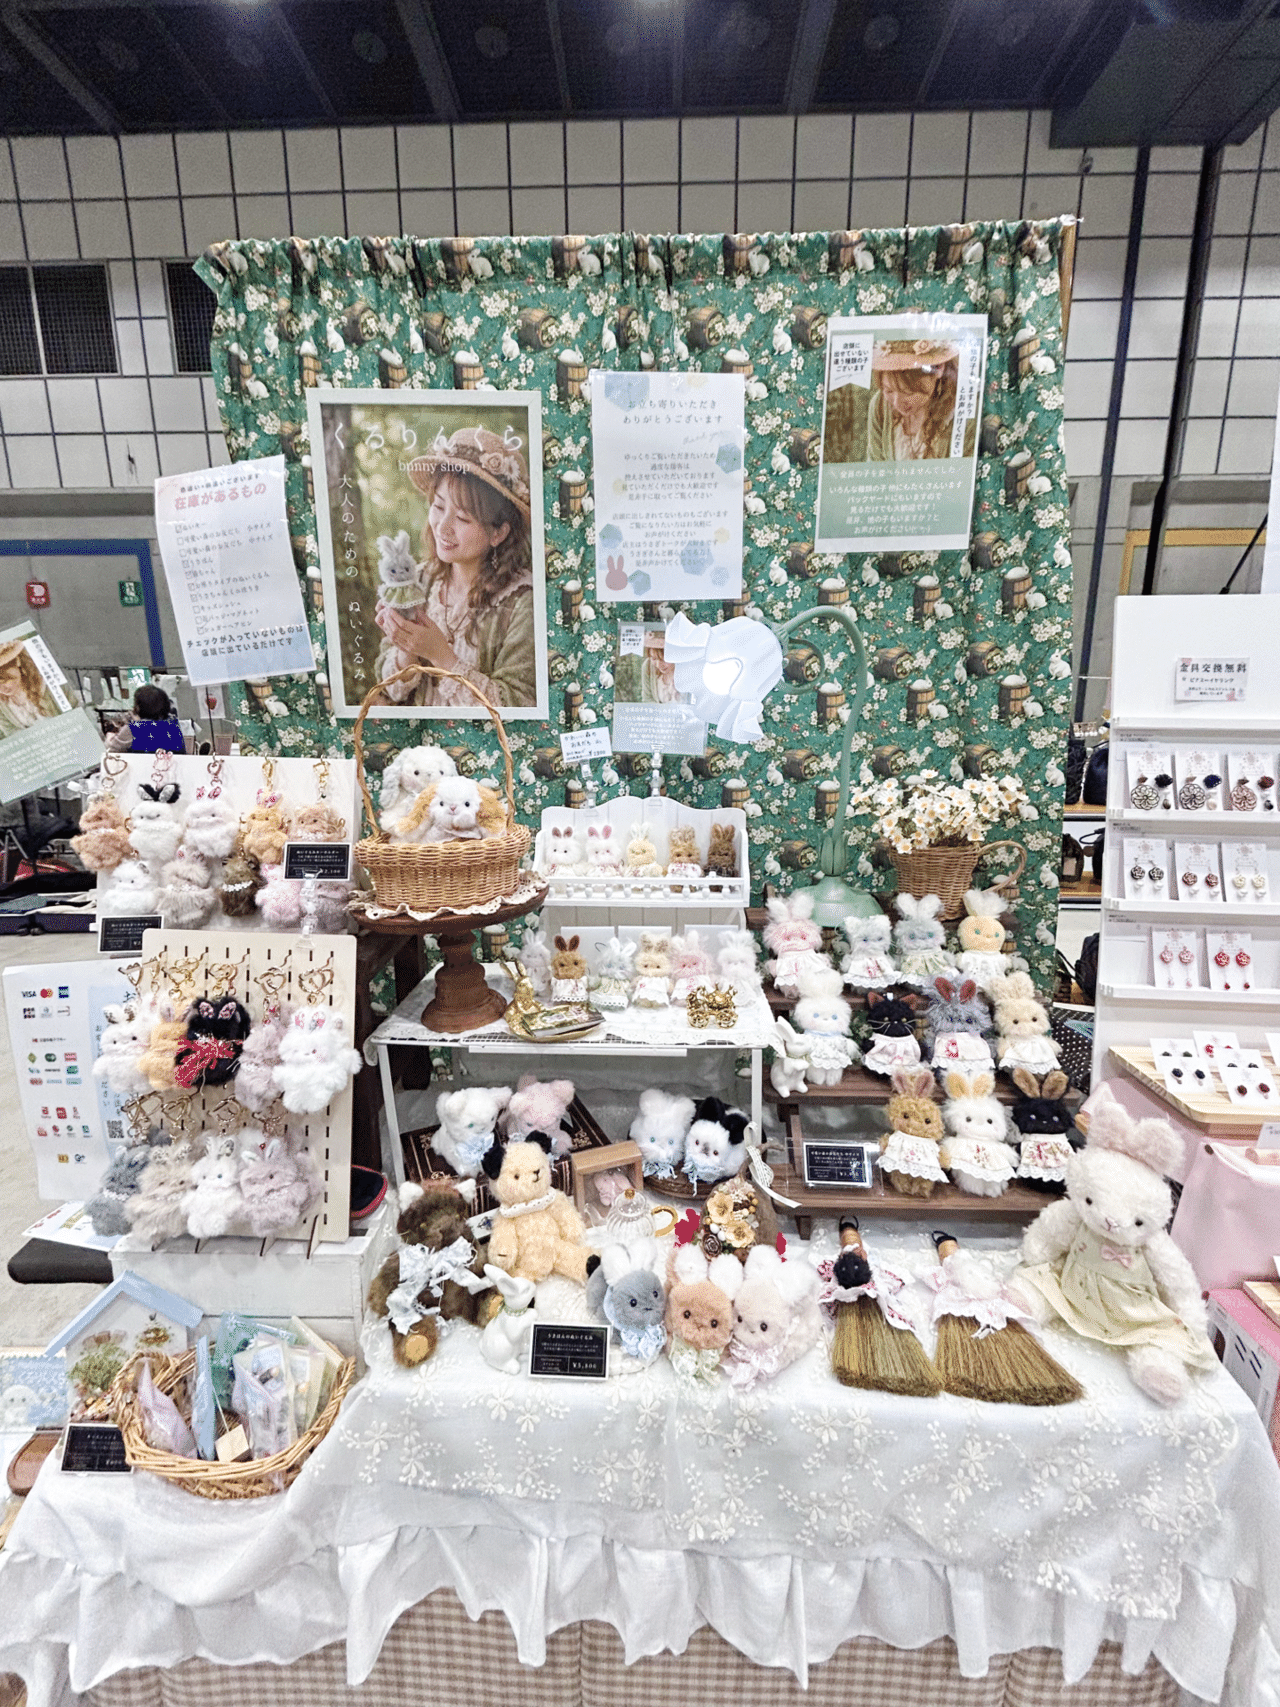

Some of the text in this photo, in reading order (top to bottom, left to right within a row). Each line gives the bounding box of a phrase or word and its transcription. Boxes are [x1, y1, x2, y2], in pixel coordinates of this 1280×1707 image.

[628, 399, 717, 409] お立ち寄りいただき
[623, 415, 722, 424] ありがとうございます
[334, 422, 522, 451] くるりんくら
[399, 461, 470, 475] bunny shop
[174, 483, 267, 511] 在庫があるもの
[645, 530, 696, 538] お声がけください
[338, 474, 366, 681] 大人のための ぬいぐるみ
[187, 625, 304, 648] チェックが入っていないものは
[1180, 662, 1246, 673] 金具交換無料
